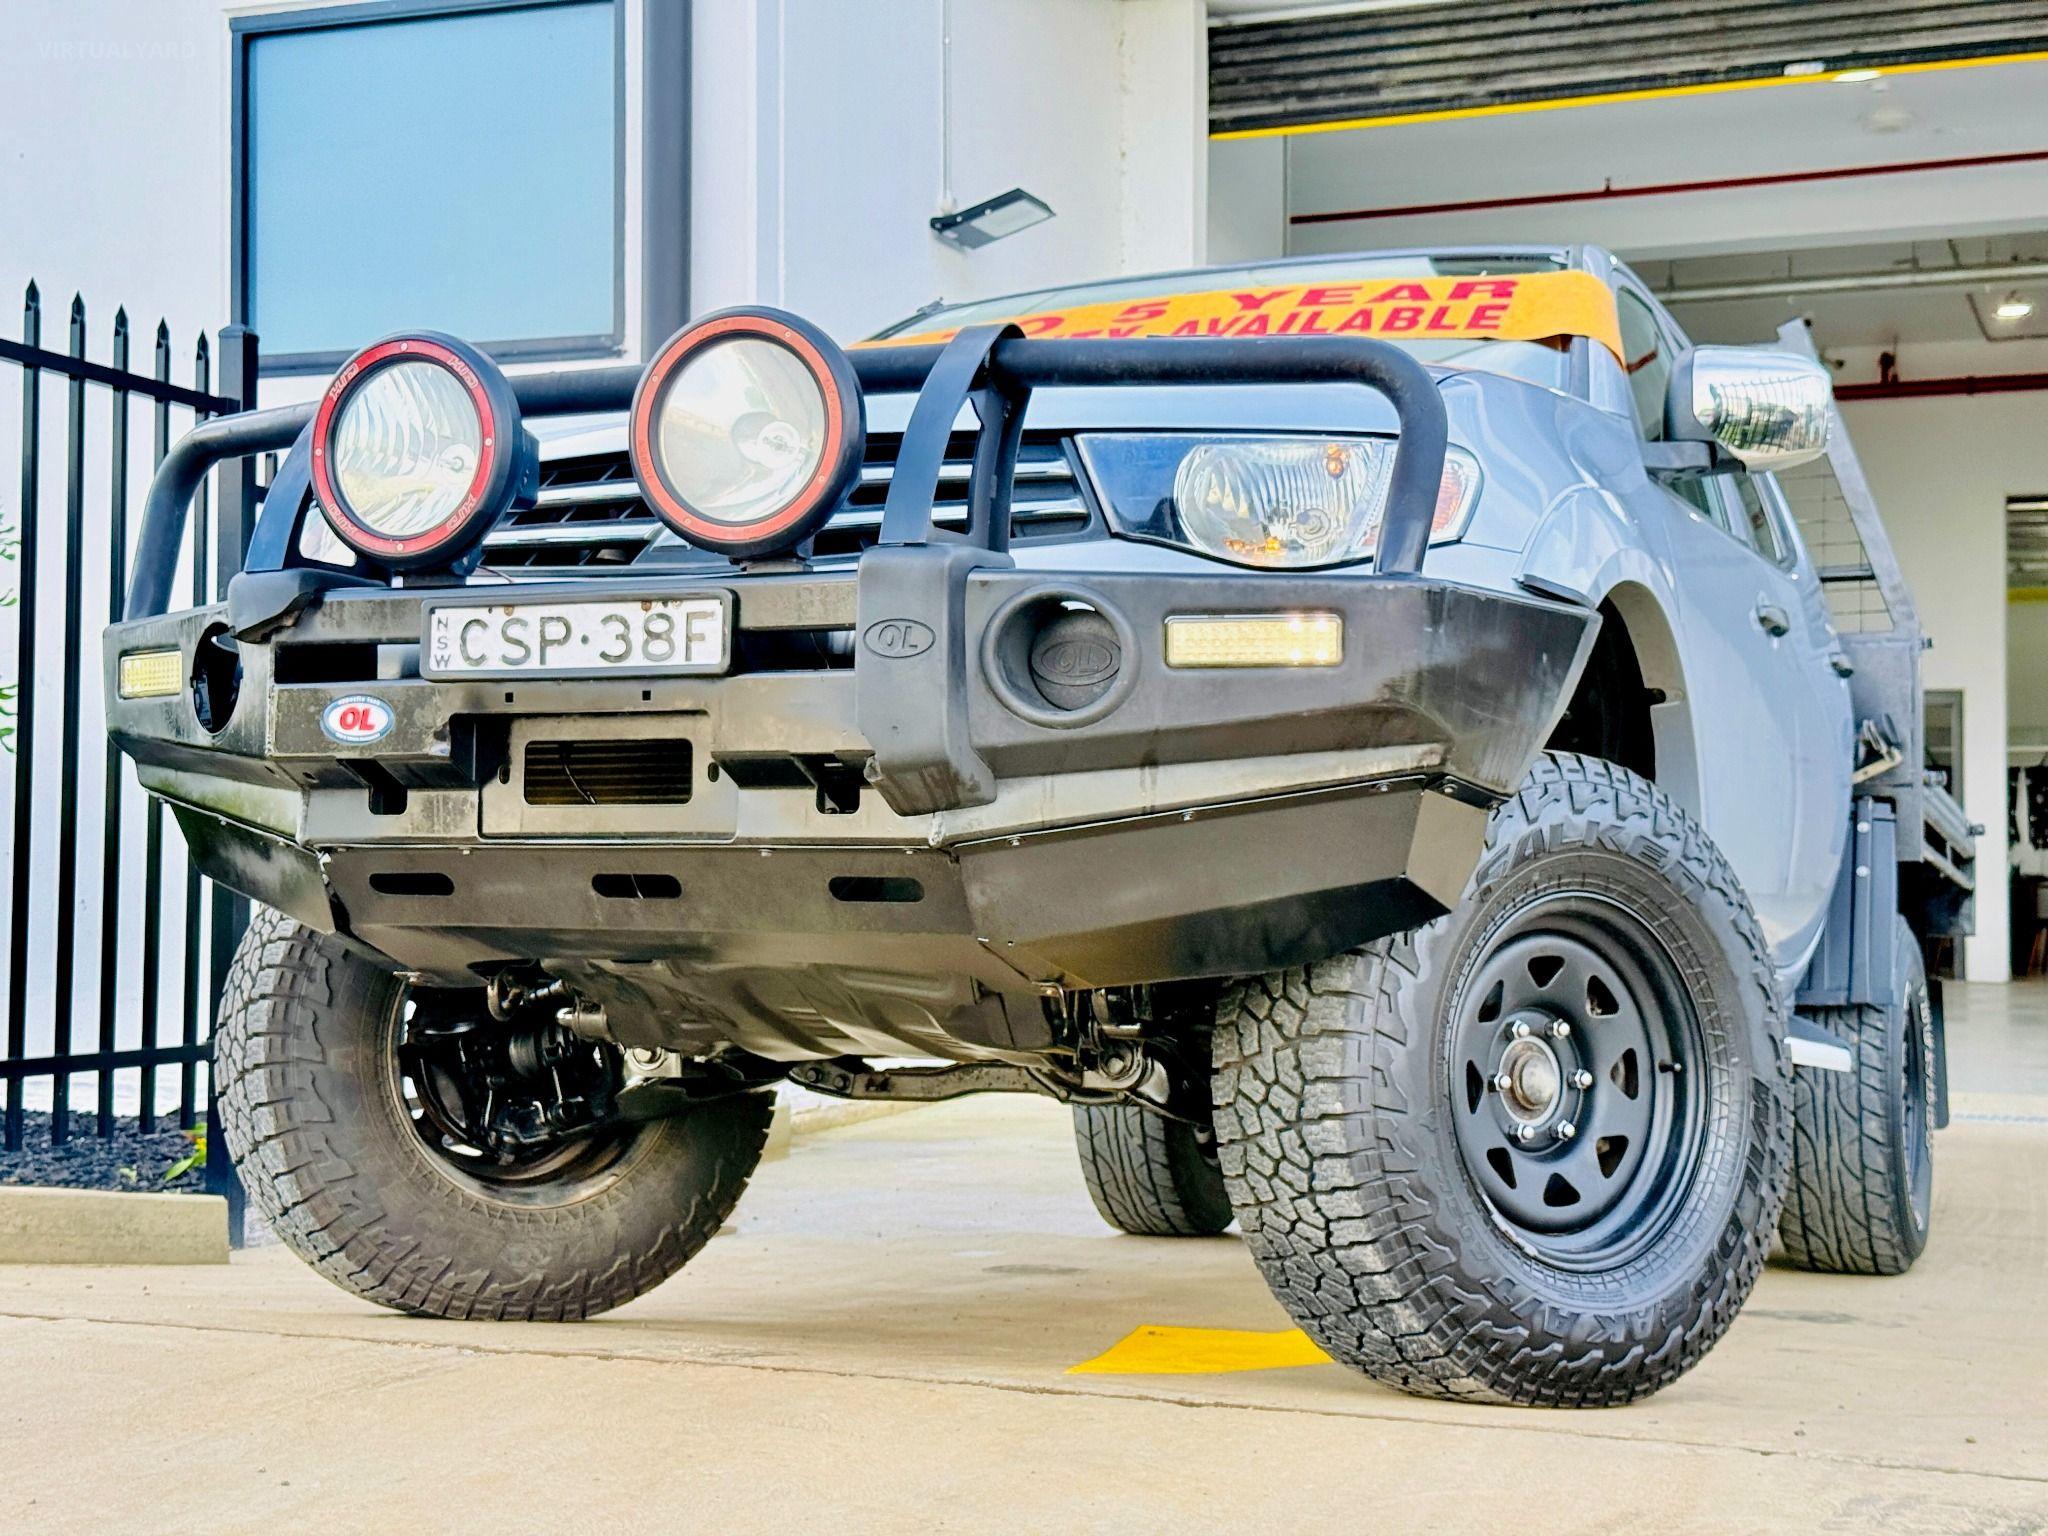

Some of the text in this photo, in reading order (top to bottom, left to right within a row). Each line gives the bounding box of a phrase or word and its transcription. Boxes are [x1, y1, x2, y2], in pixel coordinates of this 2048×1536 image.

[1112, 301, 1171, 323] 5
[1230, 280, 1519, 313] YEAR
[1170, 303, 1509, 337] AVAILABLE
[878, 624, 918, 649] OL
[339, 706, 376, 731] OL
[1468, 819, 1706, 905] FALKEN
